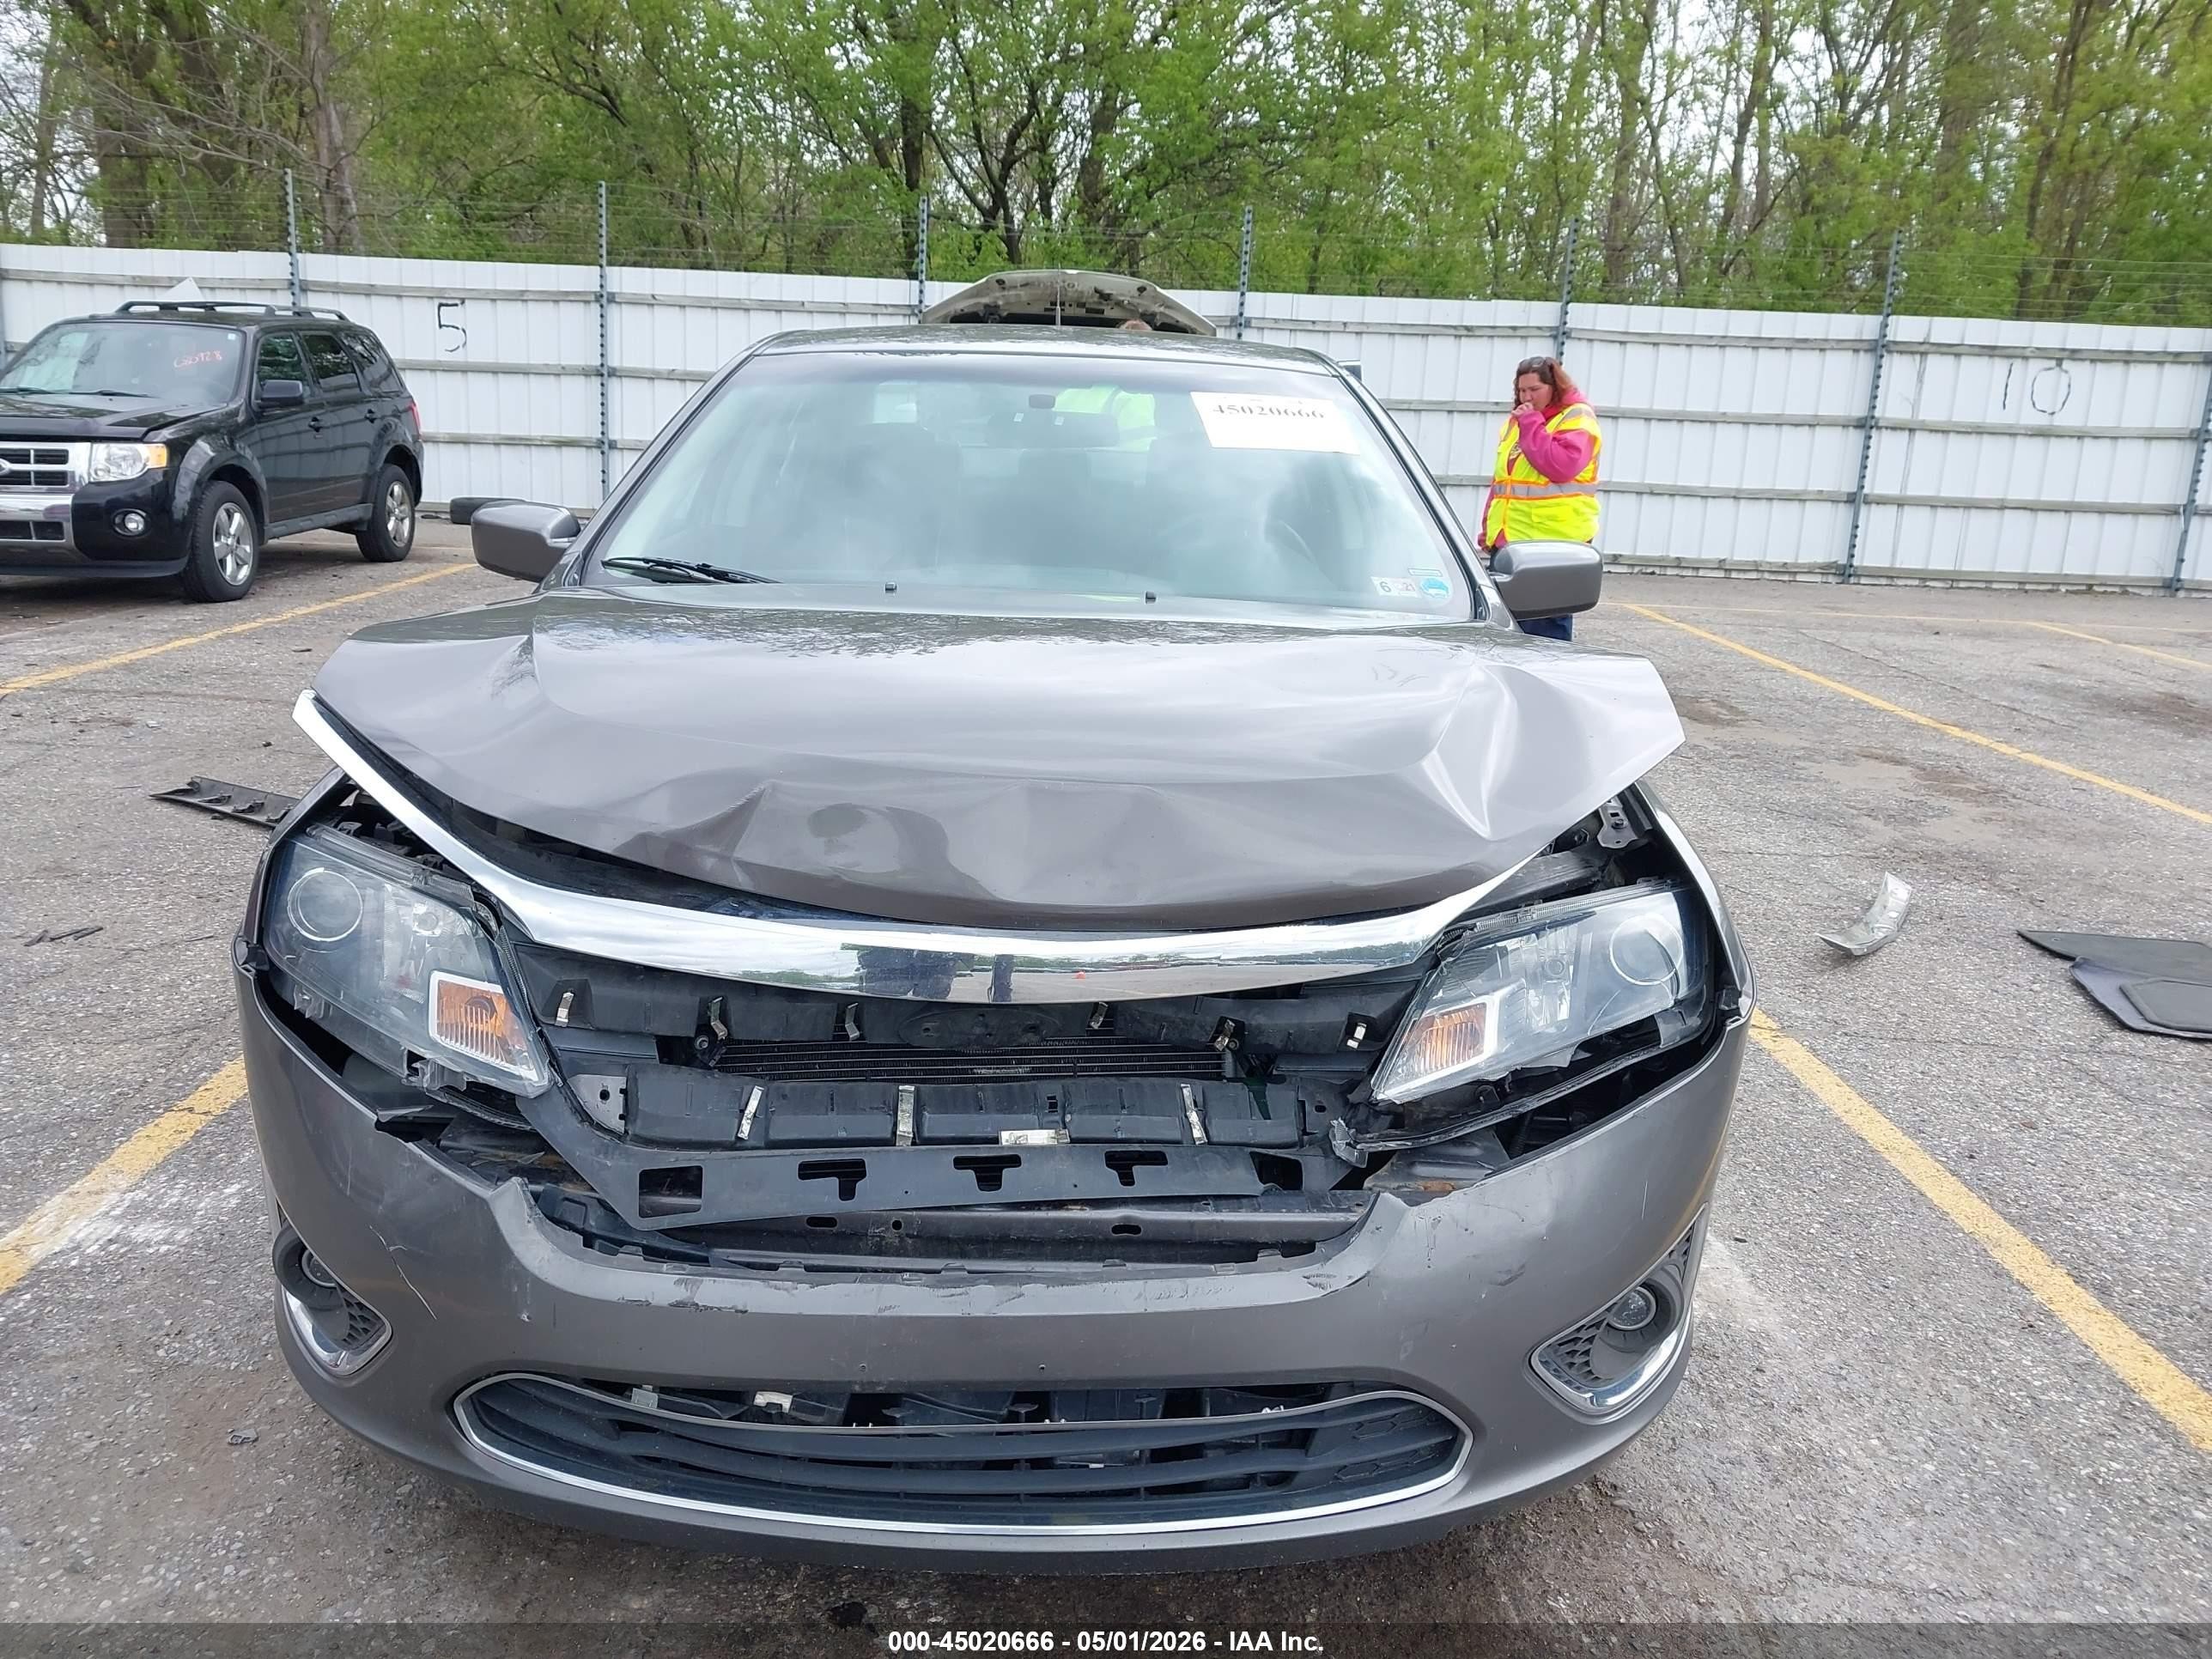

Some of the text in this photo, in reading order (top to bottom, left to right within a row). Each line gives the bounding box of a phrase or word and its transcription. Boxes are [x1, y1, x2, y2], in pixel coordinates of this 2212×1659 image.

[437, 300, 467, 353] 5
[2002, 362, 2071, 416] 10
[1212, 404, 1325, 419] 45020666
[1379, 581, 1391, 592] 6
